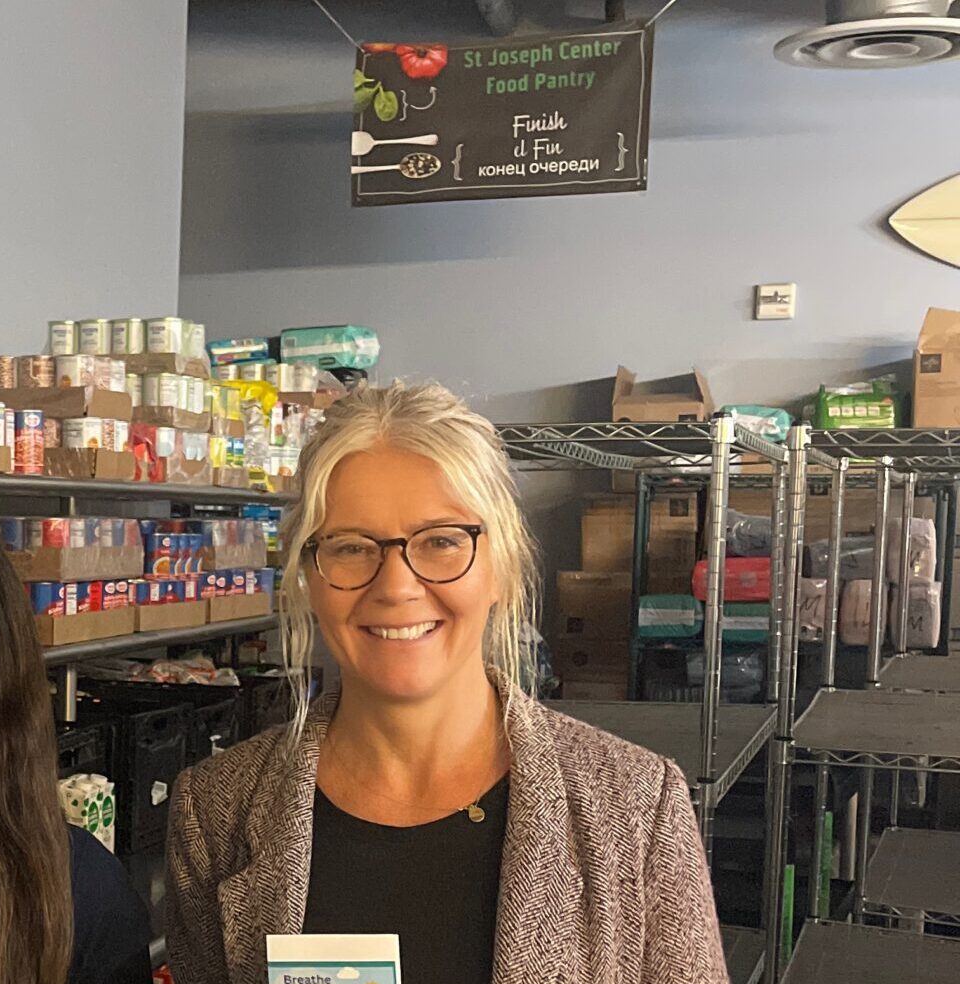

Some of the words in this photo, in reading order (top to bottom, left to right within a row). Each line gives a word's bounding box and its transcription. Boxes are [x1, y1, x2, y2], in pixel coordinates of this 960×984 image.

[464, 51, 482, 68] St
[488, 45, 553, 68] Joseph
[559, 40, 621, 60] Center
[486, 75, 528, 94] Food
[535, 70, 596, 92] Pantry
[512, 111, 568, 139] Finish
[533, 137, 564, 160] Fin
[478, 162, 526, 177] конец
[529, 158, 600, 176] очереди
[283, 974, 332, 984] Breathe
